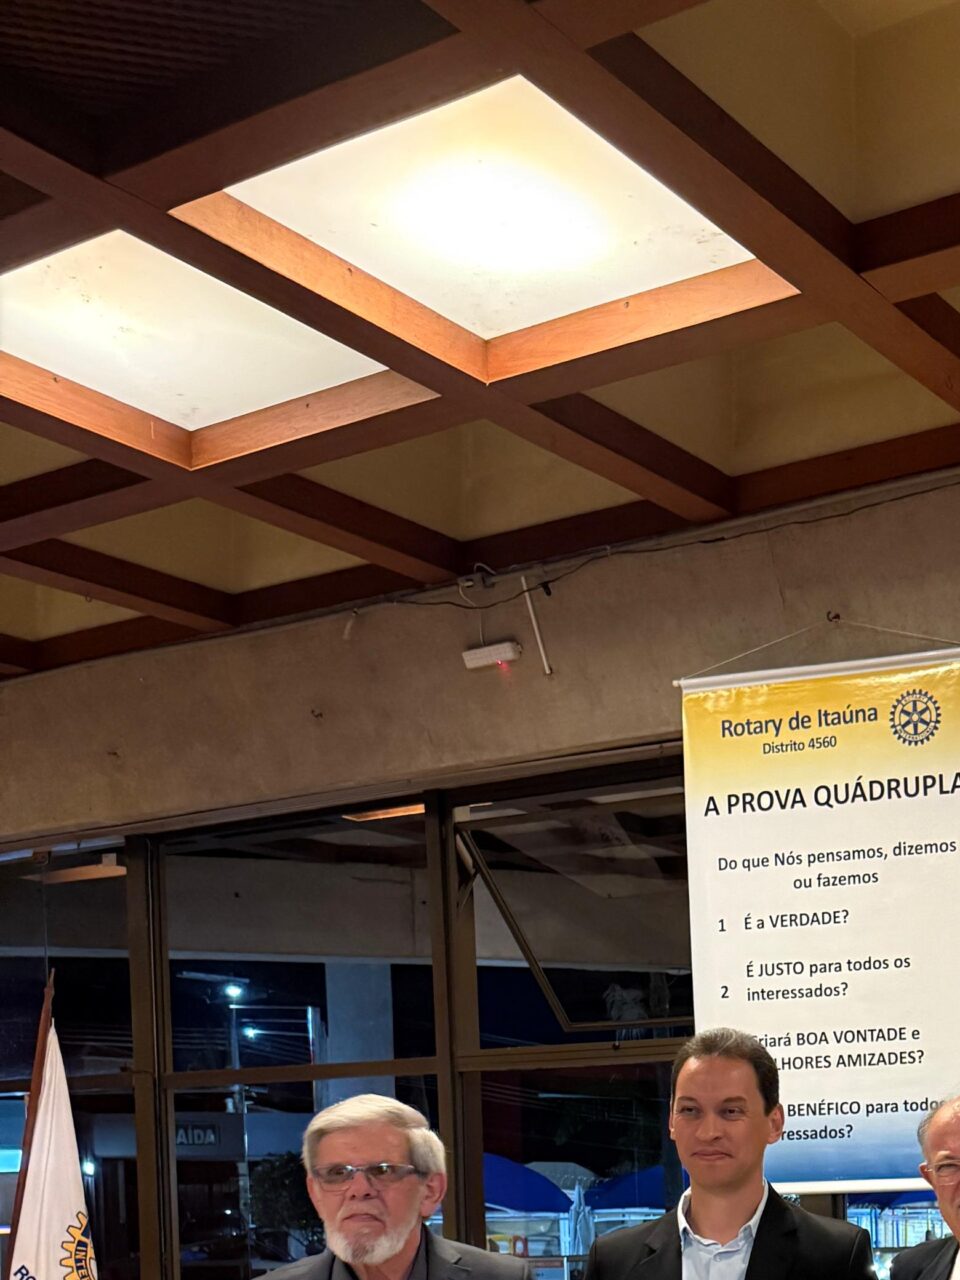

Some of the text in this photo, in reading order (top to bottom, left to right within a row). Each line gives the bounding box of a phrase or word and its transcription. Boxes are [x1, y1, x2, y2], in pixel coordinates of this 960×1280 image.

[720, 703, 878, 739] Rotary de Itaúna
[762, 735, 837, 755] Distrito 4560
[704, 796, 720, 817] A
[727, 788, 807, 815] PROVA
[718, 840, 957, 872] Do que Nós pensamos, dizemos
[793, 872, 879, 889] ou fazemos
[718, 909, 849, 932] 1 É a VERDADE?
[746, 956, 911, 977] É JUSTO para todos os
[720, 982, 848, 1001] 2 interessados?
[796, 1032, 829, 1047] BOA
[833, 1027, 906, 1044] VONTADE
[911, 1029, 920, 1040] e
[836, 1050, 924, 1068] AMIZADES?
[787, 1099, 861, 1117] BENÉFICO
[866, 1101, 899, 1117] para
[177, 1124, 215, 1144] AÍDA
[781, 1125, 853, 1141] ressados?
